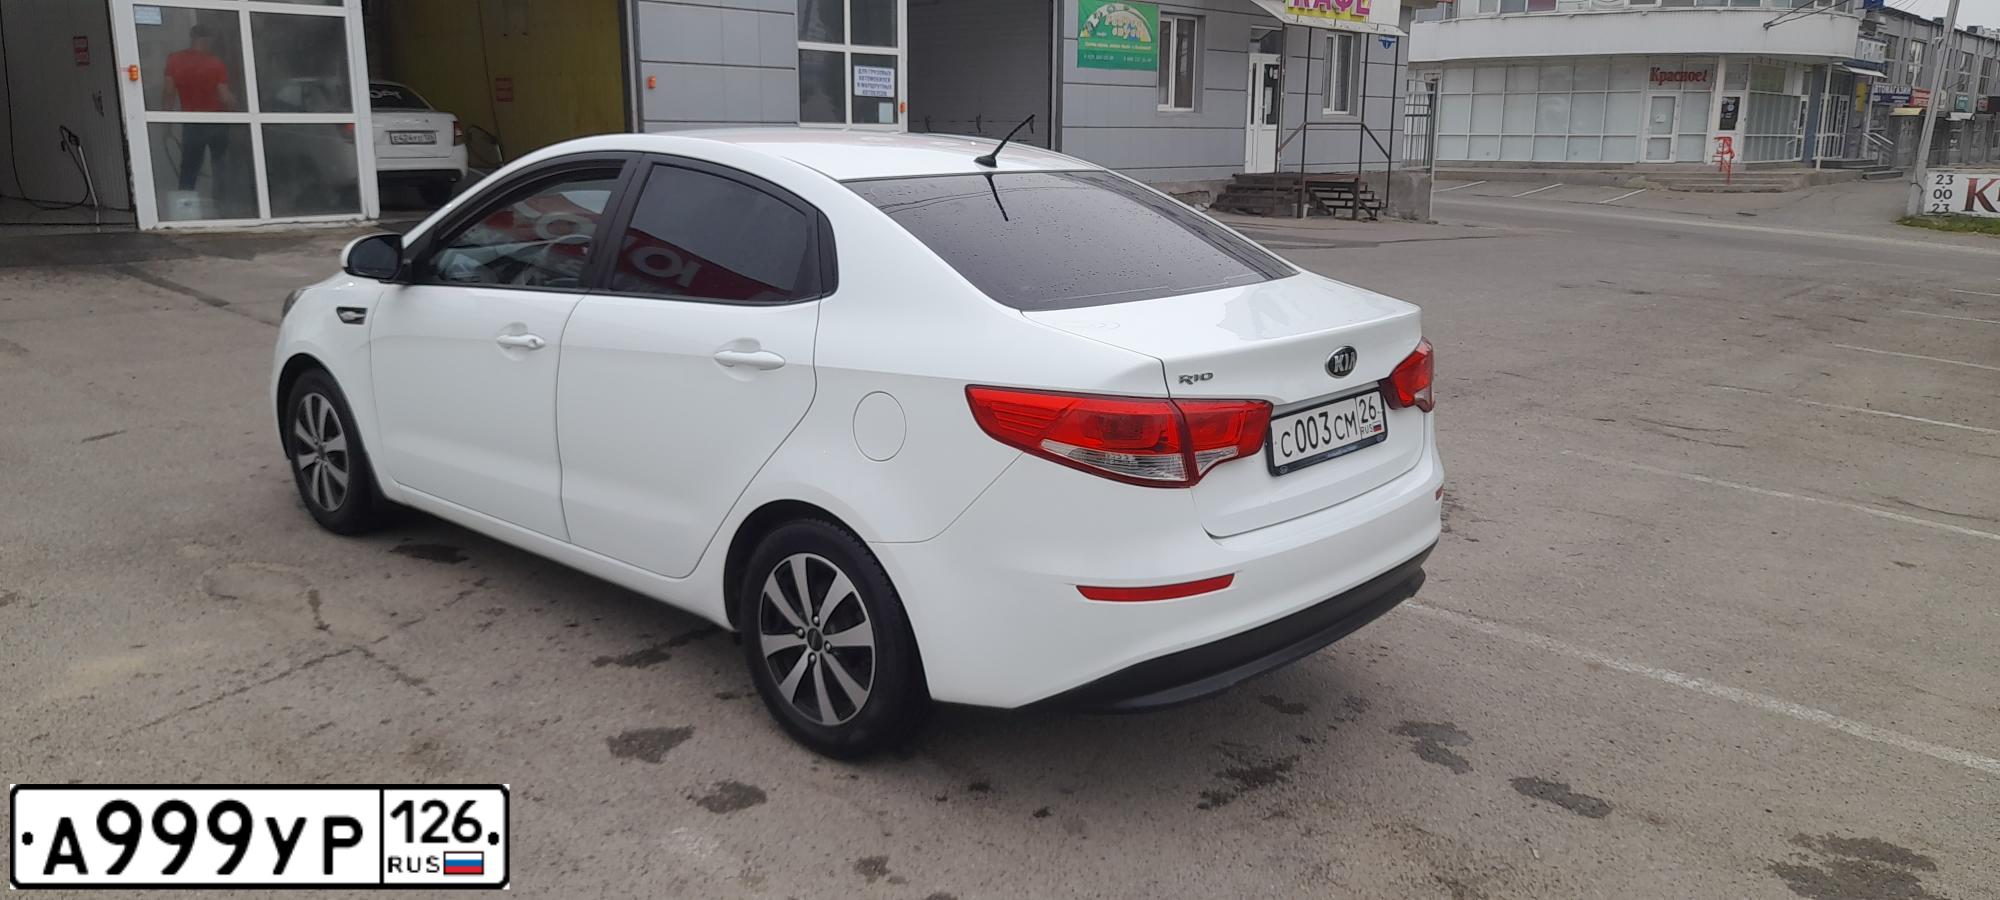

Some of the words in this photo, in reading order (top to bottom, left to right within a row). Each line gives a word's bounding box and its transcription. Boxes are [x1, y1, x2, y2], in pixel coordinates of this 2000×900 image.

[1935, 174, 1954, 185] 23
[1933, 188, 1953, 200] 00
[1961, 177, 2000, 213] К
[1932, 203, 1950, 213] 23
[1334, 351, 1356, 373] KIA
[1178, 372, 1214, 385] RIO
[1280, 411, 1358, 458] С003СМ
[1358, 396, 1377, 424] 26
[1360, 423, 1374, 435] RUS
